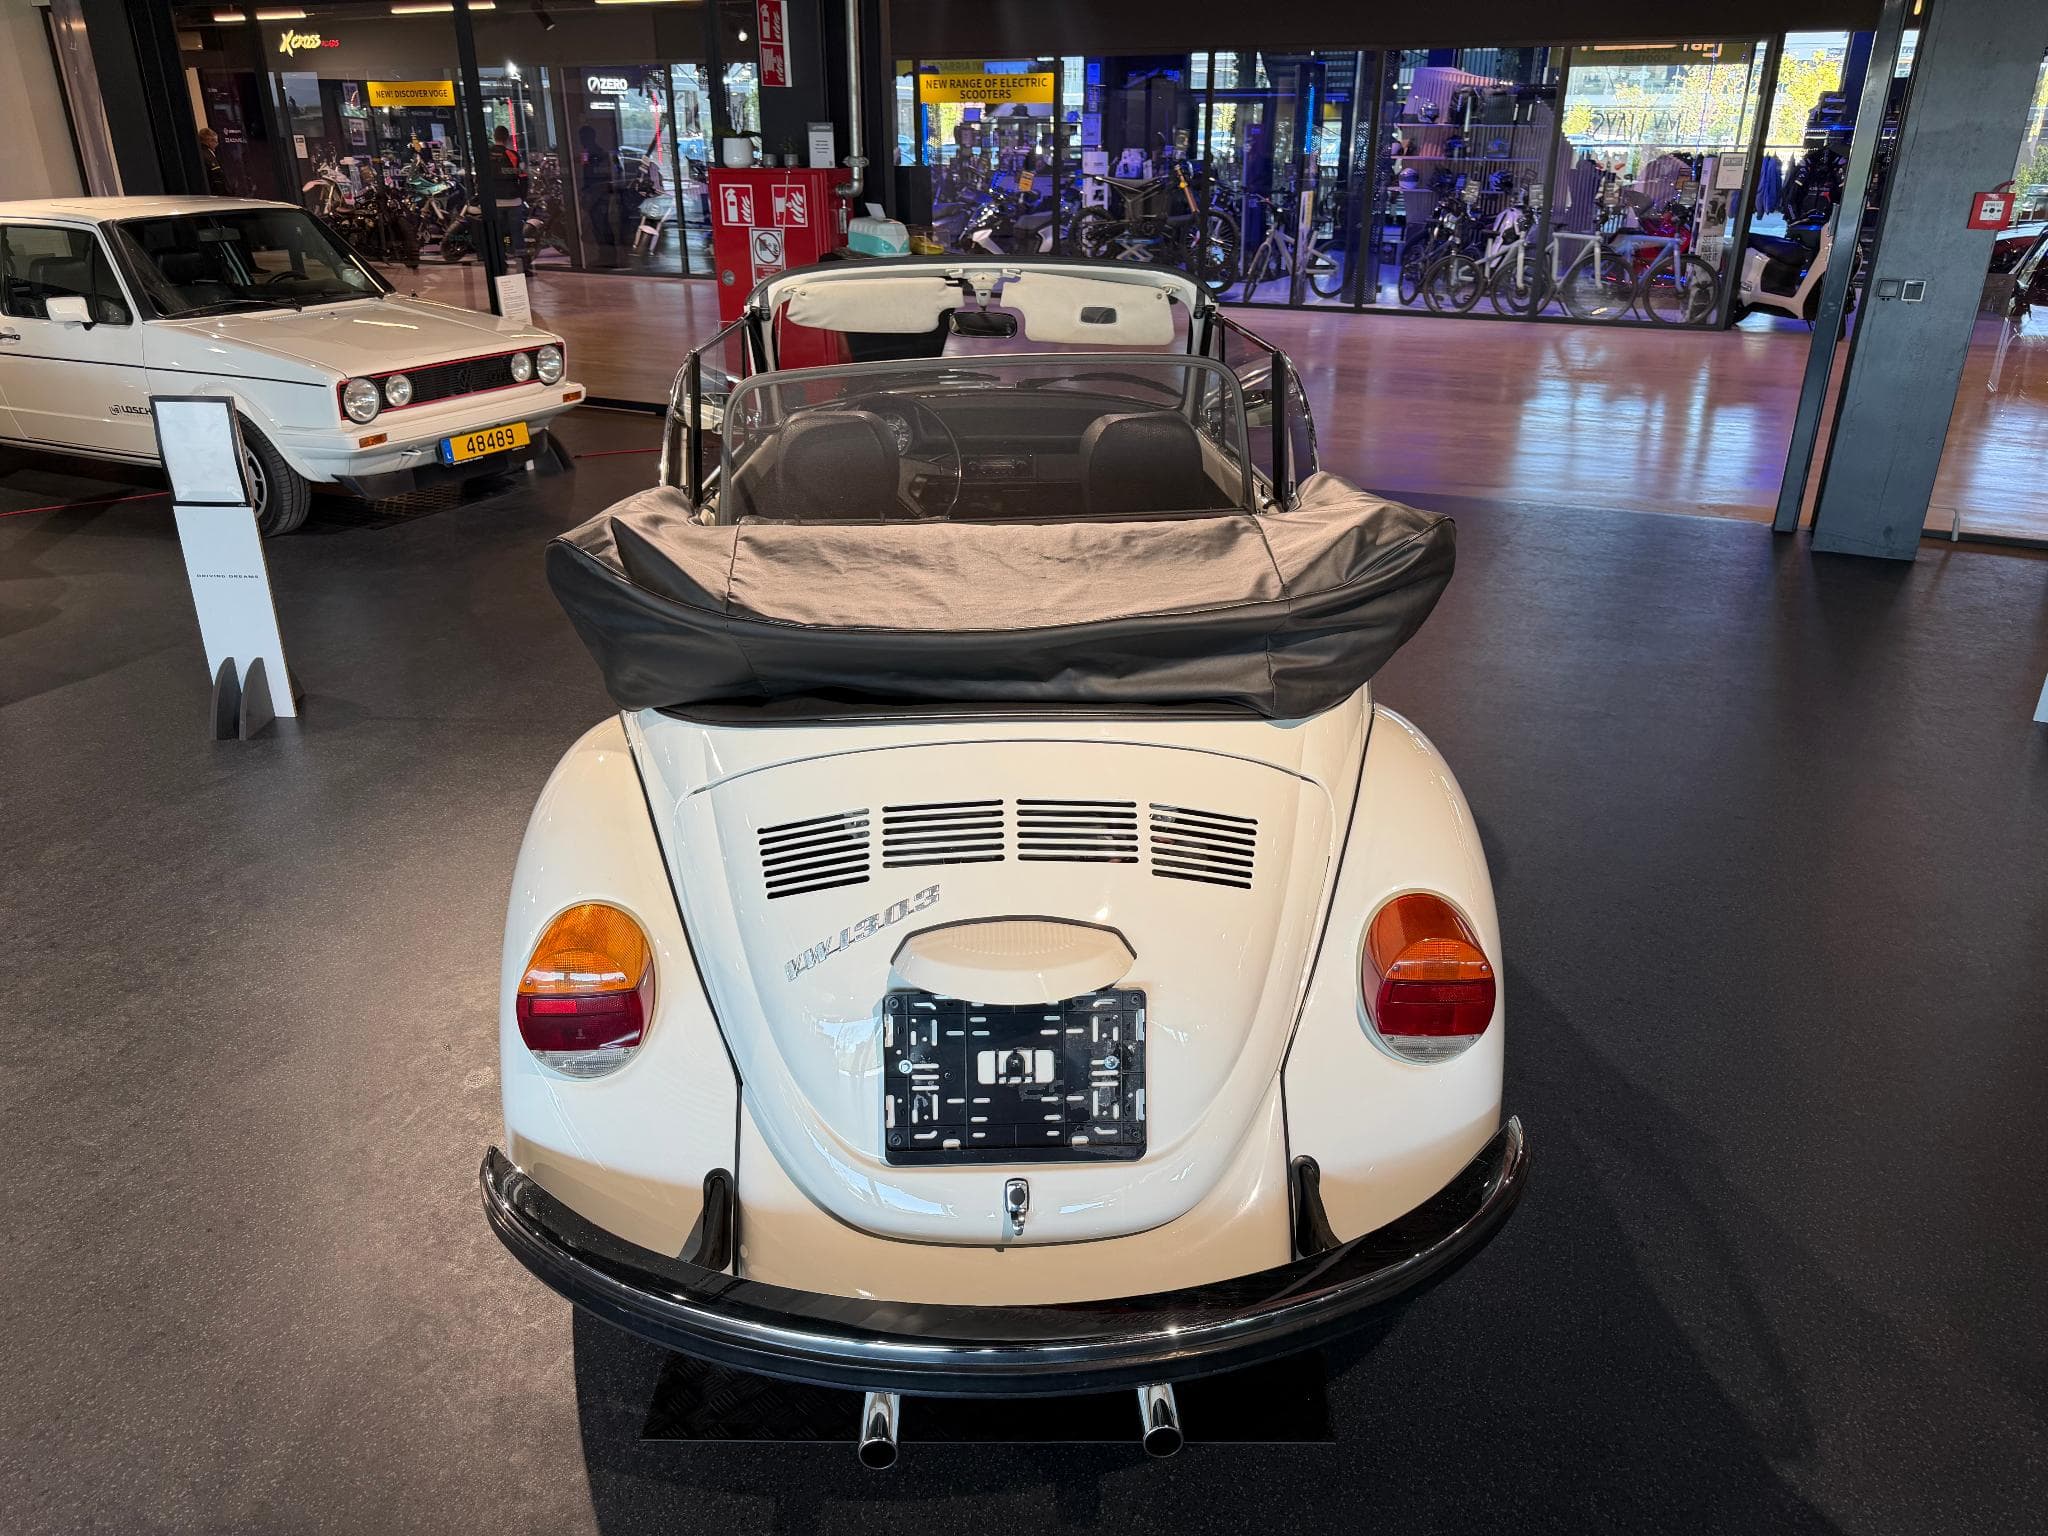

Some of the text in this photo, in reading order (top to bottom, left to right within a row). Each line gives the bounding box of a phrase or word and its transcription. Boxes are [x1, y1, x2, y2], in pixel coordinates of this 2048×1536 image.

[600, 78, 628, 90] ZERO
[926, 77, 1048, 89] NEW RANGE OF ELECTRIC
[375, 89, 448, 98] NEW! DISCOVER VOGE
[960, 89, 1012, 99] SCOOTERS
[120, 405, 152, 415] LOSCH
[466, 428, 515, 454] 48489
